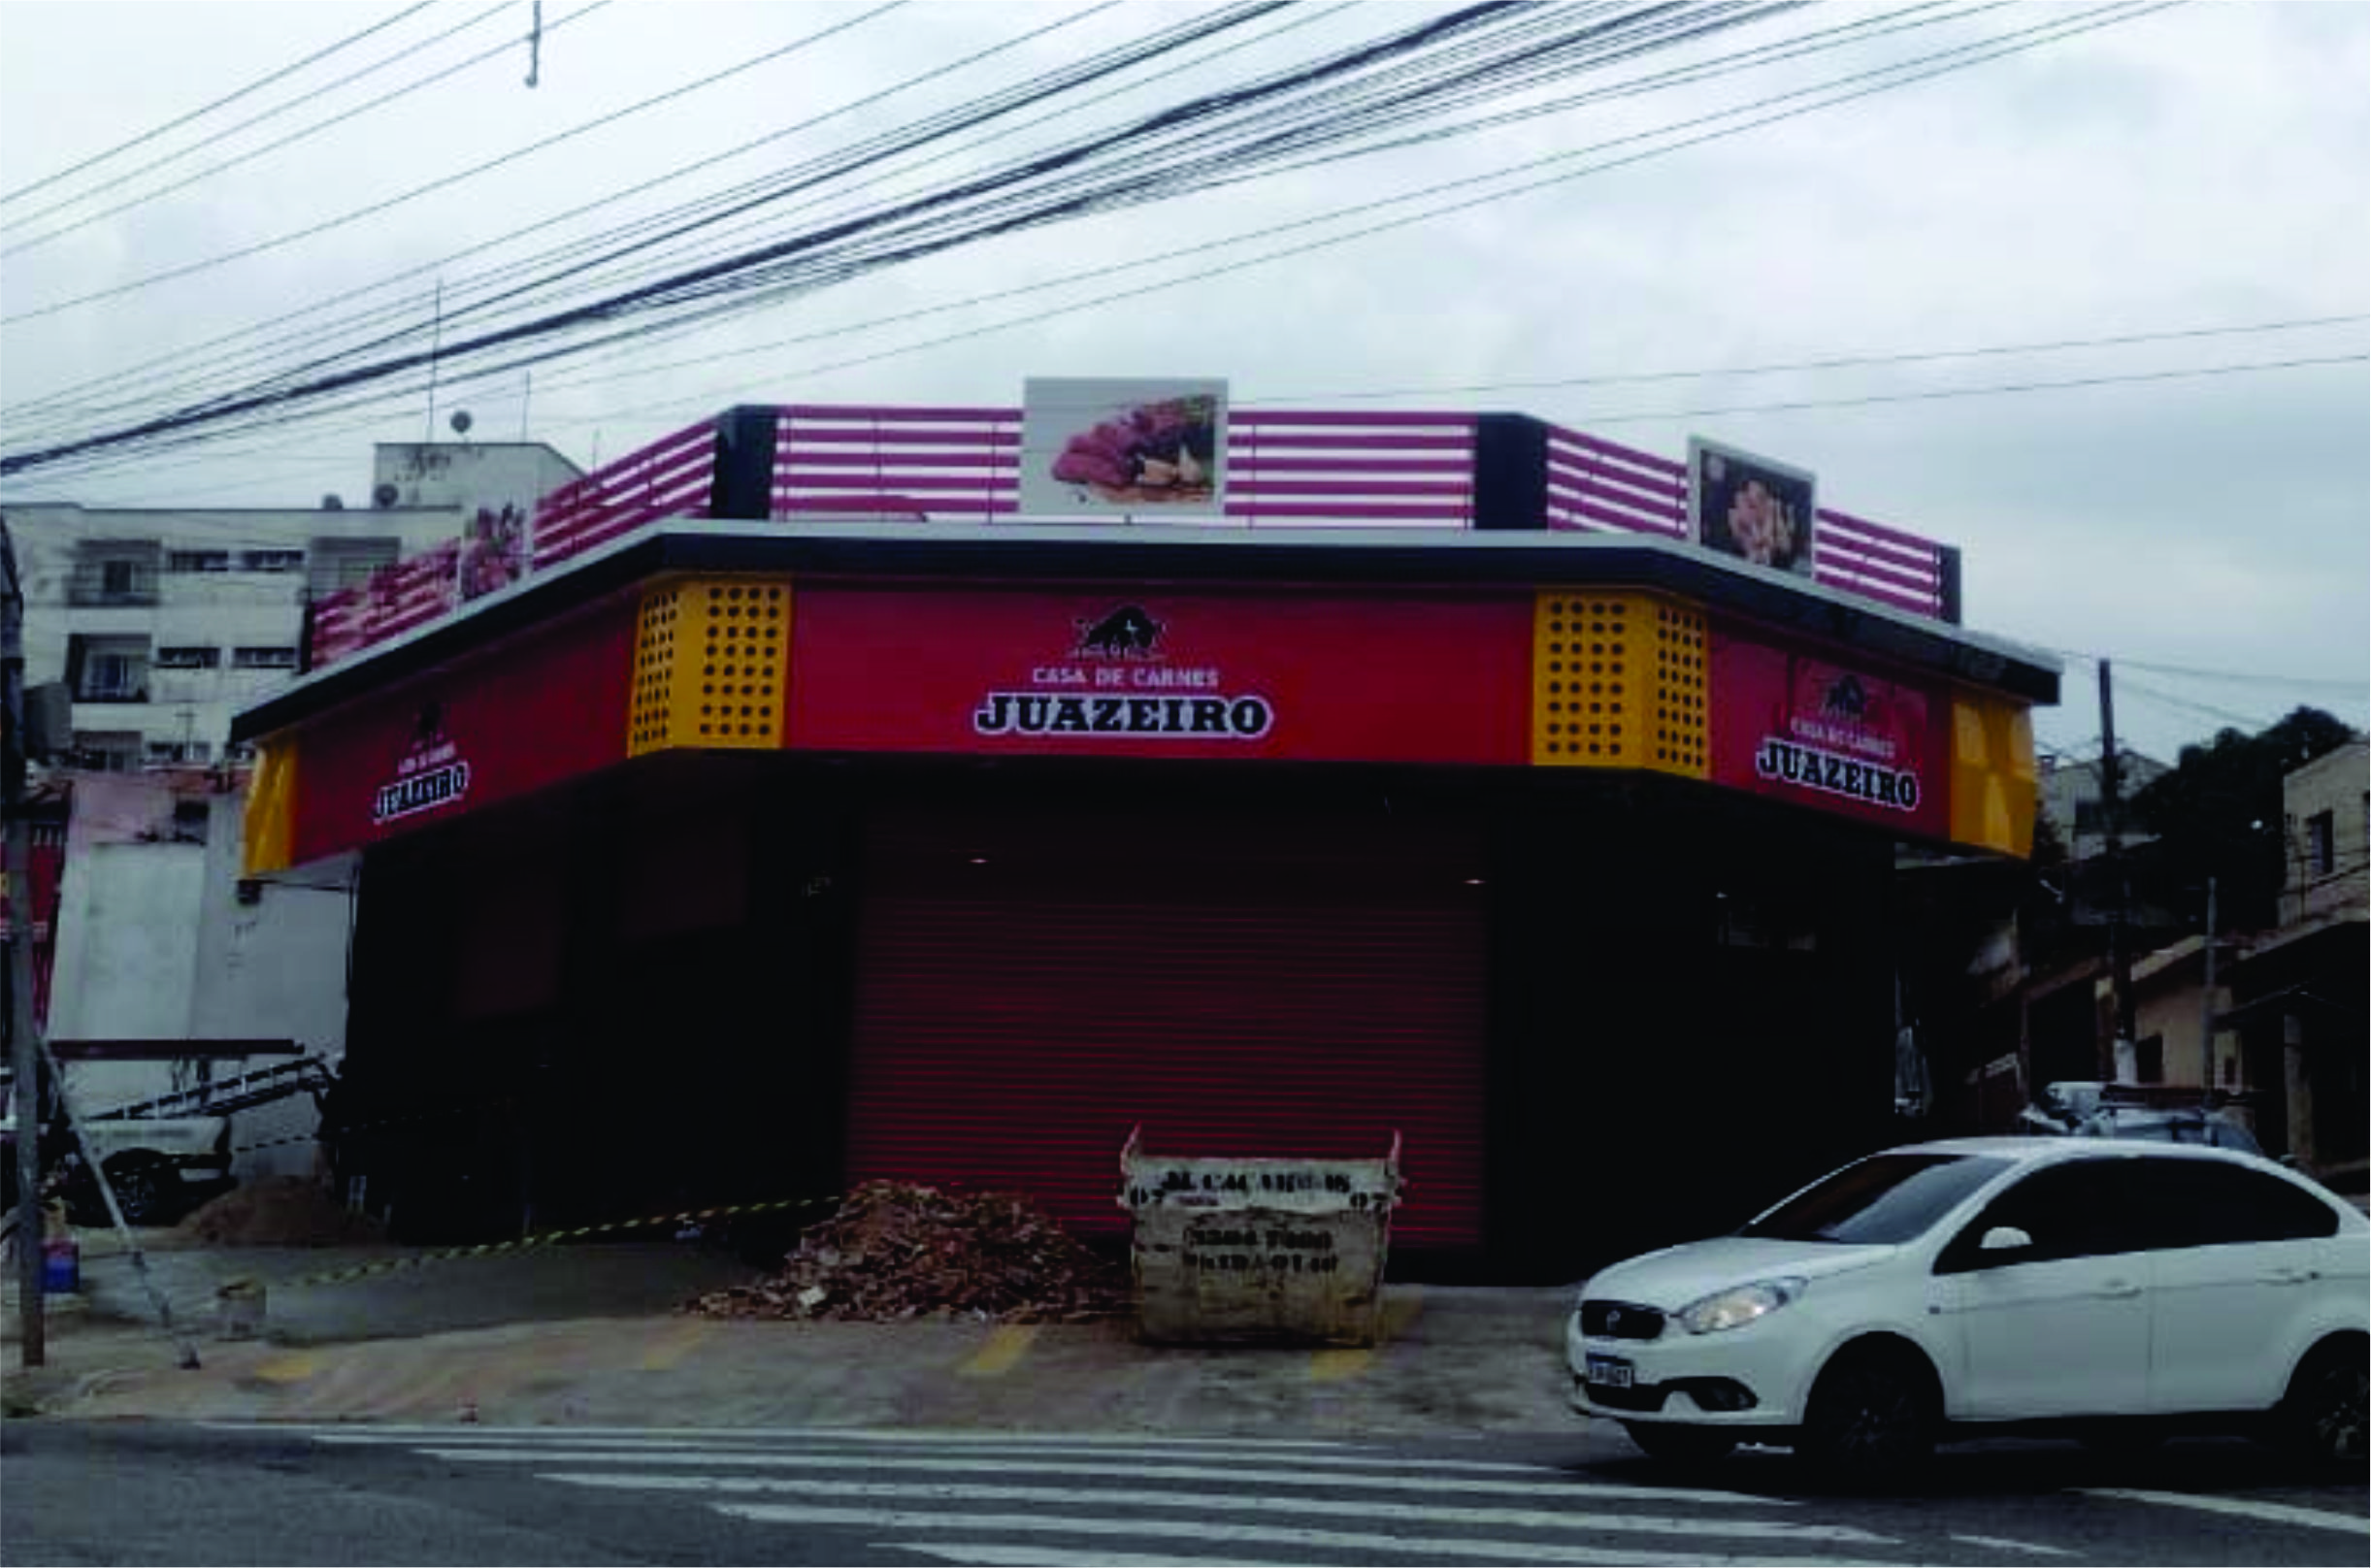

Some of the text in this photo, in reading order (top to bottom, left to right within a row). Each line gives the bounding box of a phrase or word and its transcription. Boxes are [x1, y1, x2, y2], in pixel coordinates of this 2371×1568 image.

[1033, 668, 1219, 688] CASA DE CARNES
[974, 693, 1272, 736] JUAZEIRO
[1757, 738, 1919, 810] JUAZEIRO
